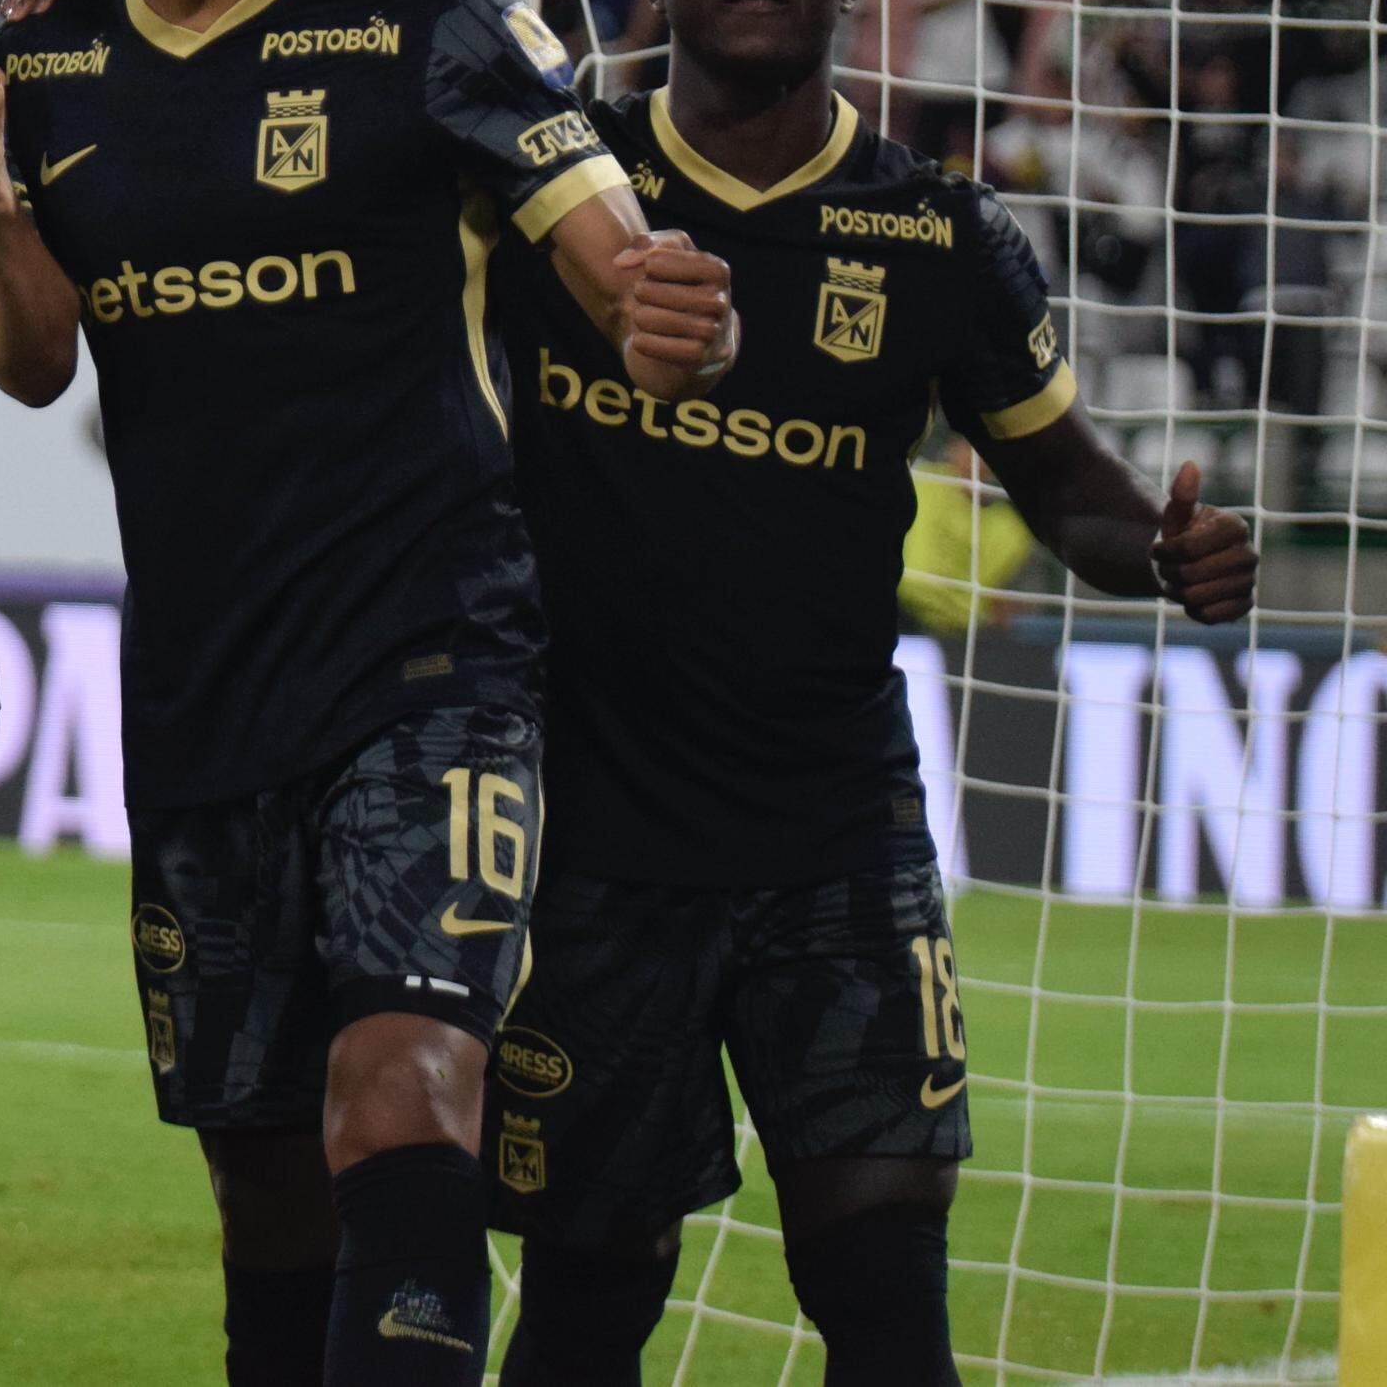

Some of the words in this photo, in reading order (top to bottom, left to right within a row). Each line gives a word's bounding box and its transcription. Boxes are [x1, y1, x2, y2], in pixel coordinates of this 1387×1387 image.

[83, 249, 356, 326] etsson
[539, 347, 867, 470] betsson
[442, 767, 525, 900] 16
[912, 937, 966, 1060] 18
